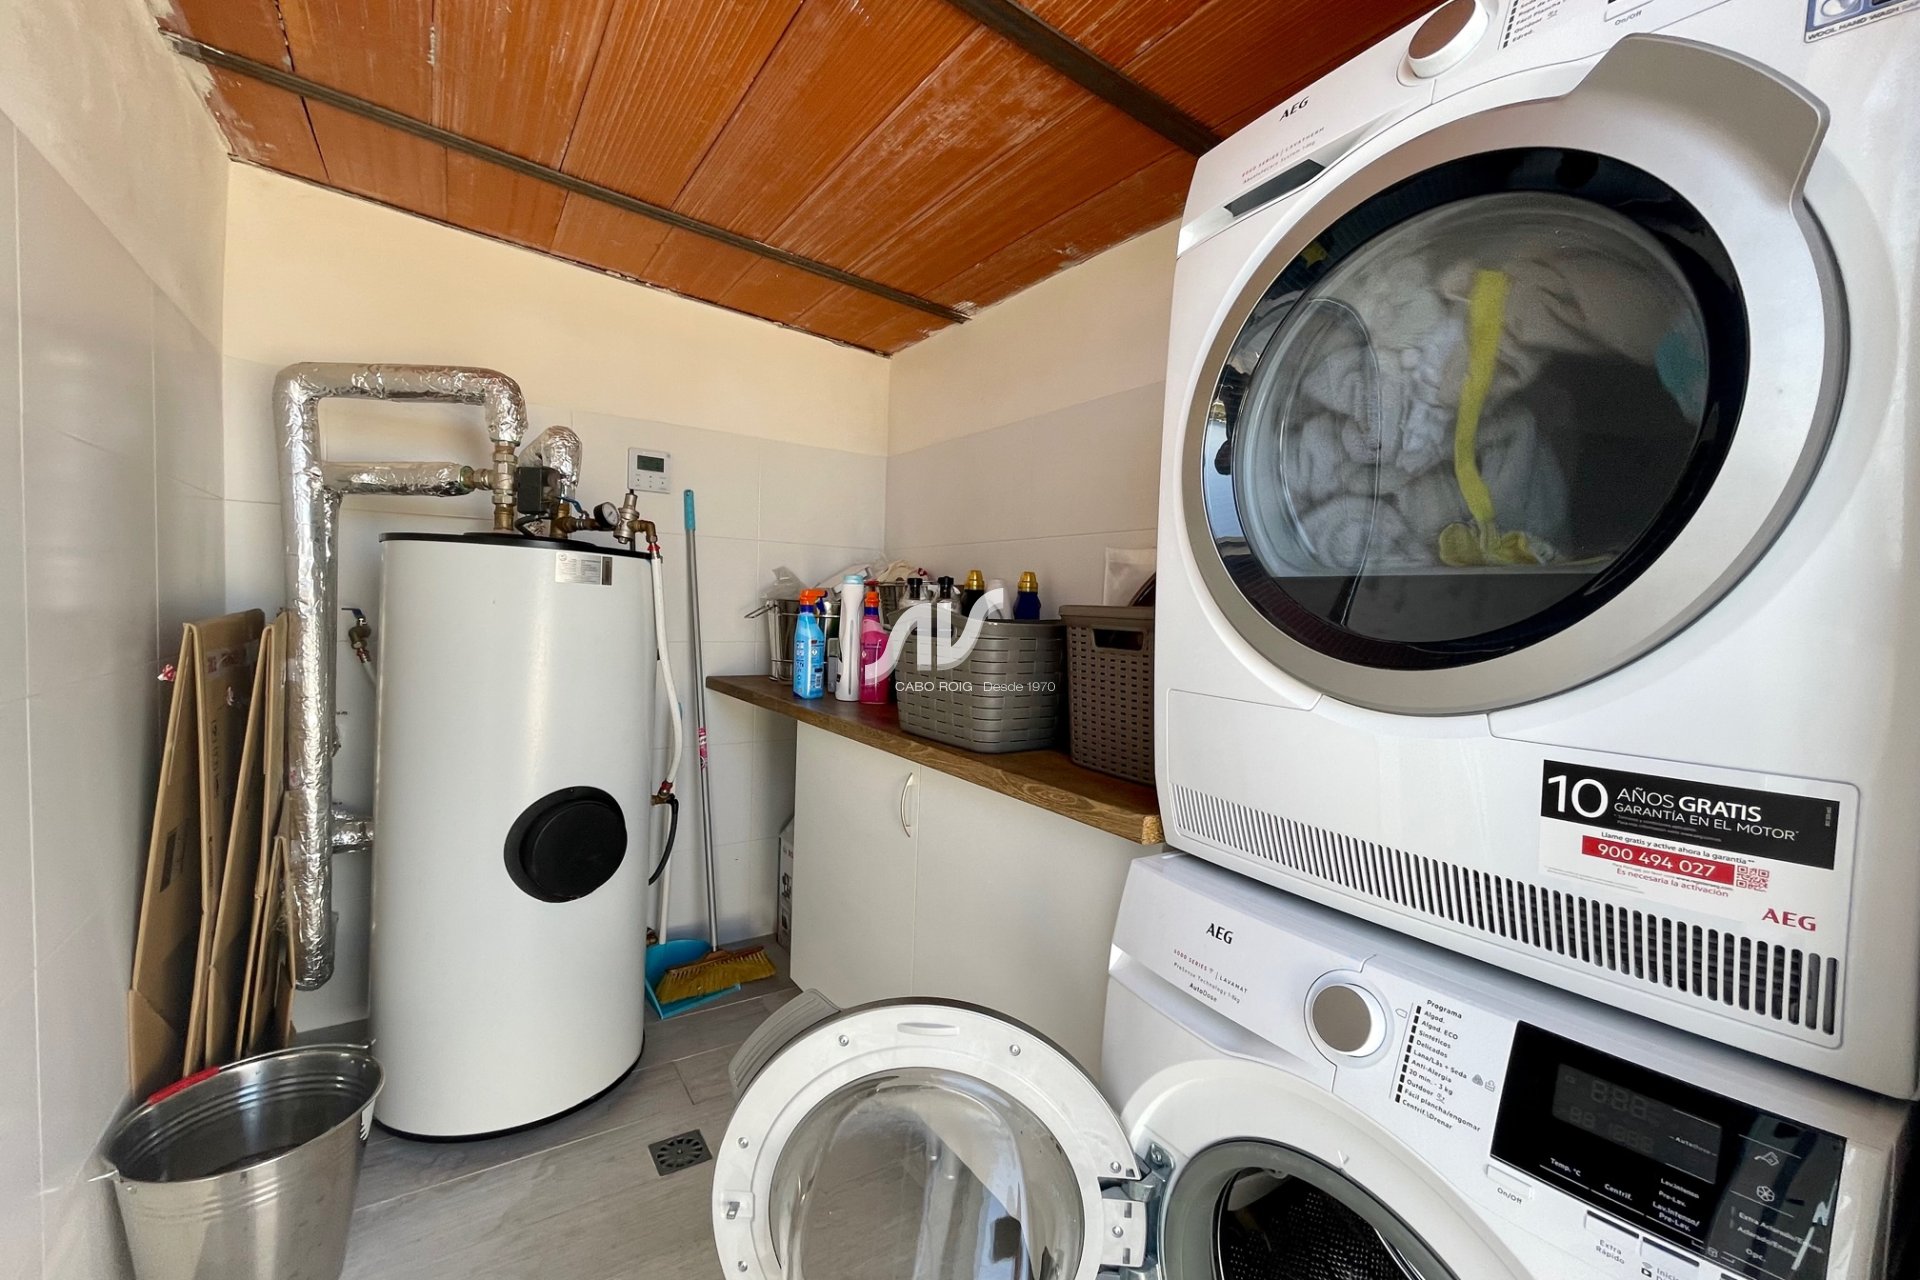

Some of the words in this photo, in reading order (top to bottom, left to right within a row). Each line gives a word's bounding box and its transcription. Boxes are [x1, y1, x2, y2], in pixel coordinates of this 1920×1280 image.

[1514, 18, 1543, 33] Outdoor
[1614, 10, 1642, 26] On/Off
[1808, 28, 1837, 40] WOOL
[1838, 17, 1867, 30] HAND
[1279, 96, 1309, 121] AEG
[1548, 774, 1609, 819] 10
[1616, 787, 1675, 809] AÑOS
[1678, 796, 1763, 823] GRATIS
[1613, 802, 1686, 823] GARANTÍA
[1689, 814, 1710, 827] EN
[1713, 819, 1732, 832] EL
[1601, 831, 1624, 842] Llame
[1624, 835, 1646, 846] gratis
[1653, 842, 1677, 852] active
[1677, 846, 1702, 857] ahora
[1702, 850, 1711, 858] la
[1597, 843, 1634, 861] 900
[1638, 852, 1674, 869] 494
[1679, 860, 1717, 878] 027
[1616, 868, 1626, 876] Es
[1627, 871, 1669, 885] necesaria
[1671, 879, 1679, 887] la
[1681, 881, 1730, 898] activación
[1761, 908, 1817, 932] AEG
[1206, 922, 1234, 945] AEG
[1189, 982, 1218, 1002] AutoDose
[1219, 975, 1248, 993] LAVAMAT
[1424, 1010, 1445, 1024] Algod.
[1426, 999, 1463, 1020] Programa
[1418, 1029, 1452, 1049] Sintéticos
[1421, 1020, 1442, 1034] Algod.
[1443, 1029, 1459, 1040] ECO
[1416, 1039, 1448, 1059] Delicados
[1411, 1059, 1452, 1083] Anti-Alergia
[1450, 1066, 1468, 1079] Seda
[1406, 1079, 1434, 1096] Outdoor
[1408, 1068, 1418, 1077] 20
[1444, 1086, 1454, 1096] kg
[1404, 1088, 1420, 1101] Fácil
[1420, 1097, 1481, 1132] plancha/engomar
[1550, 1157, 1572, 1173] Temp.
[1496, 1187, 1522, 1205] On/Off
[1604, 1183, 1633, 1201] Centrif.
[1658, 1211, 1691, 1232] Pre-Lav.
[1595, 1245, 1625, 1265] Rápido
[1599, 1239, 1622, 1256] Extra
[1745, 1247, 1766, 1263] Opc.
